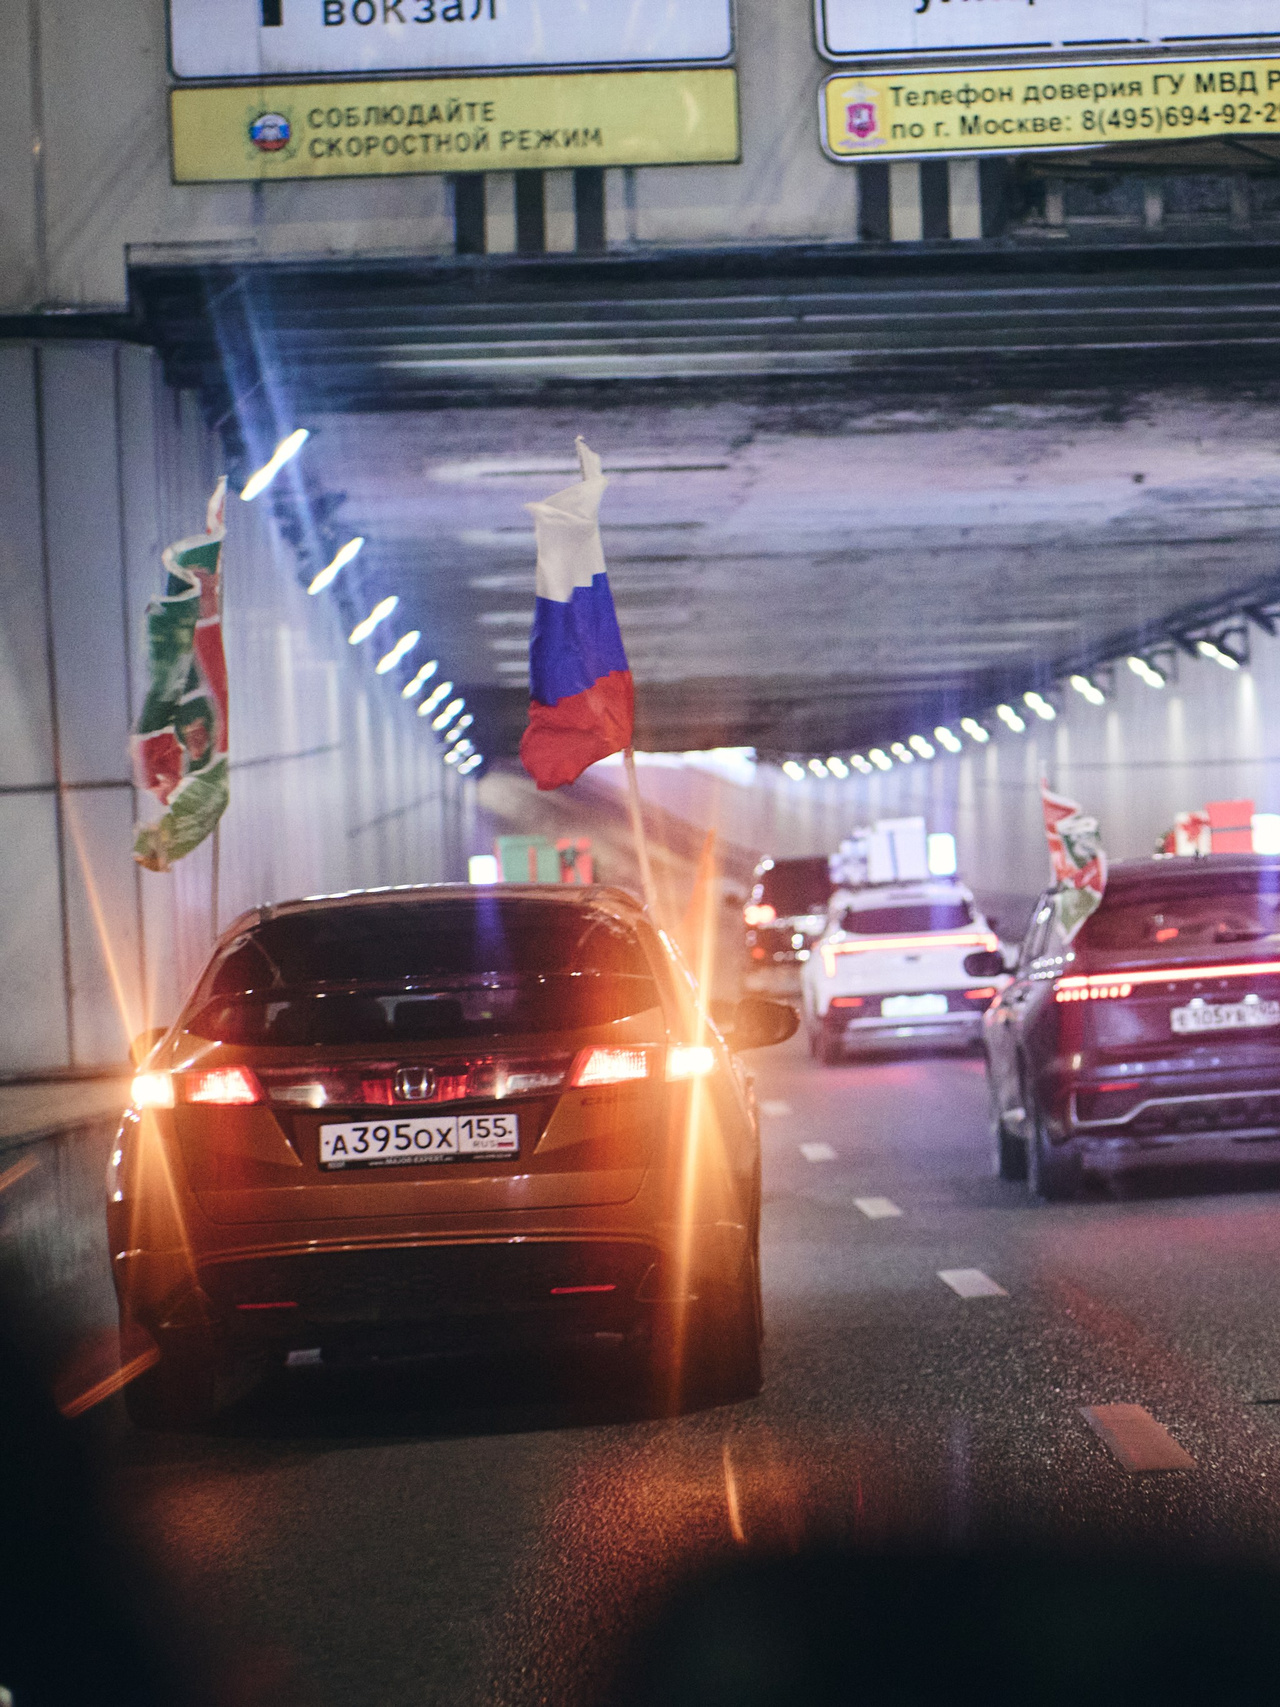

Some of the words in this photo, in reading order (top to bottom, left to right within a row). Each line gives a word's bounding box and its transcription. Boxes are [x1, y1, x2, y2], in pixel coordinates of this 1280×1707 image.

[888, 81, 1013, 108] Телефон
[1022, 79, 1143, 105] доверия
[1152, 74, 1184, 97] ГУ
[1194, 70, 1258, 95] МВД
[307, 98, 496, 128] СОБЛЮДАЙТЕ
[890, 120, 924, 140] по
[933, 119, 950, 137] г.
[960, 112, 1073, 136] Москве:
[307, 125, 491, 159] СКОРОСТНОЙ
[501, 127, 603, 150] РЕЖИМ
[461, 1117, 508, 1139] 155
